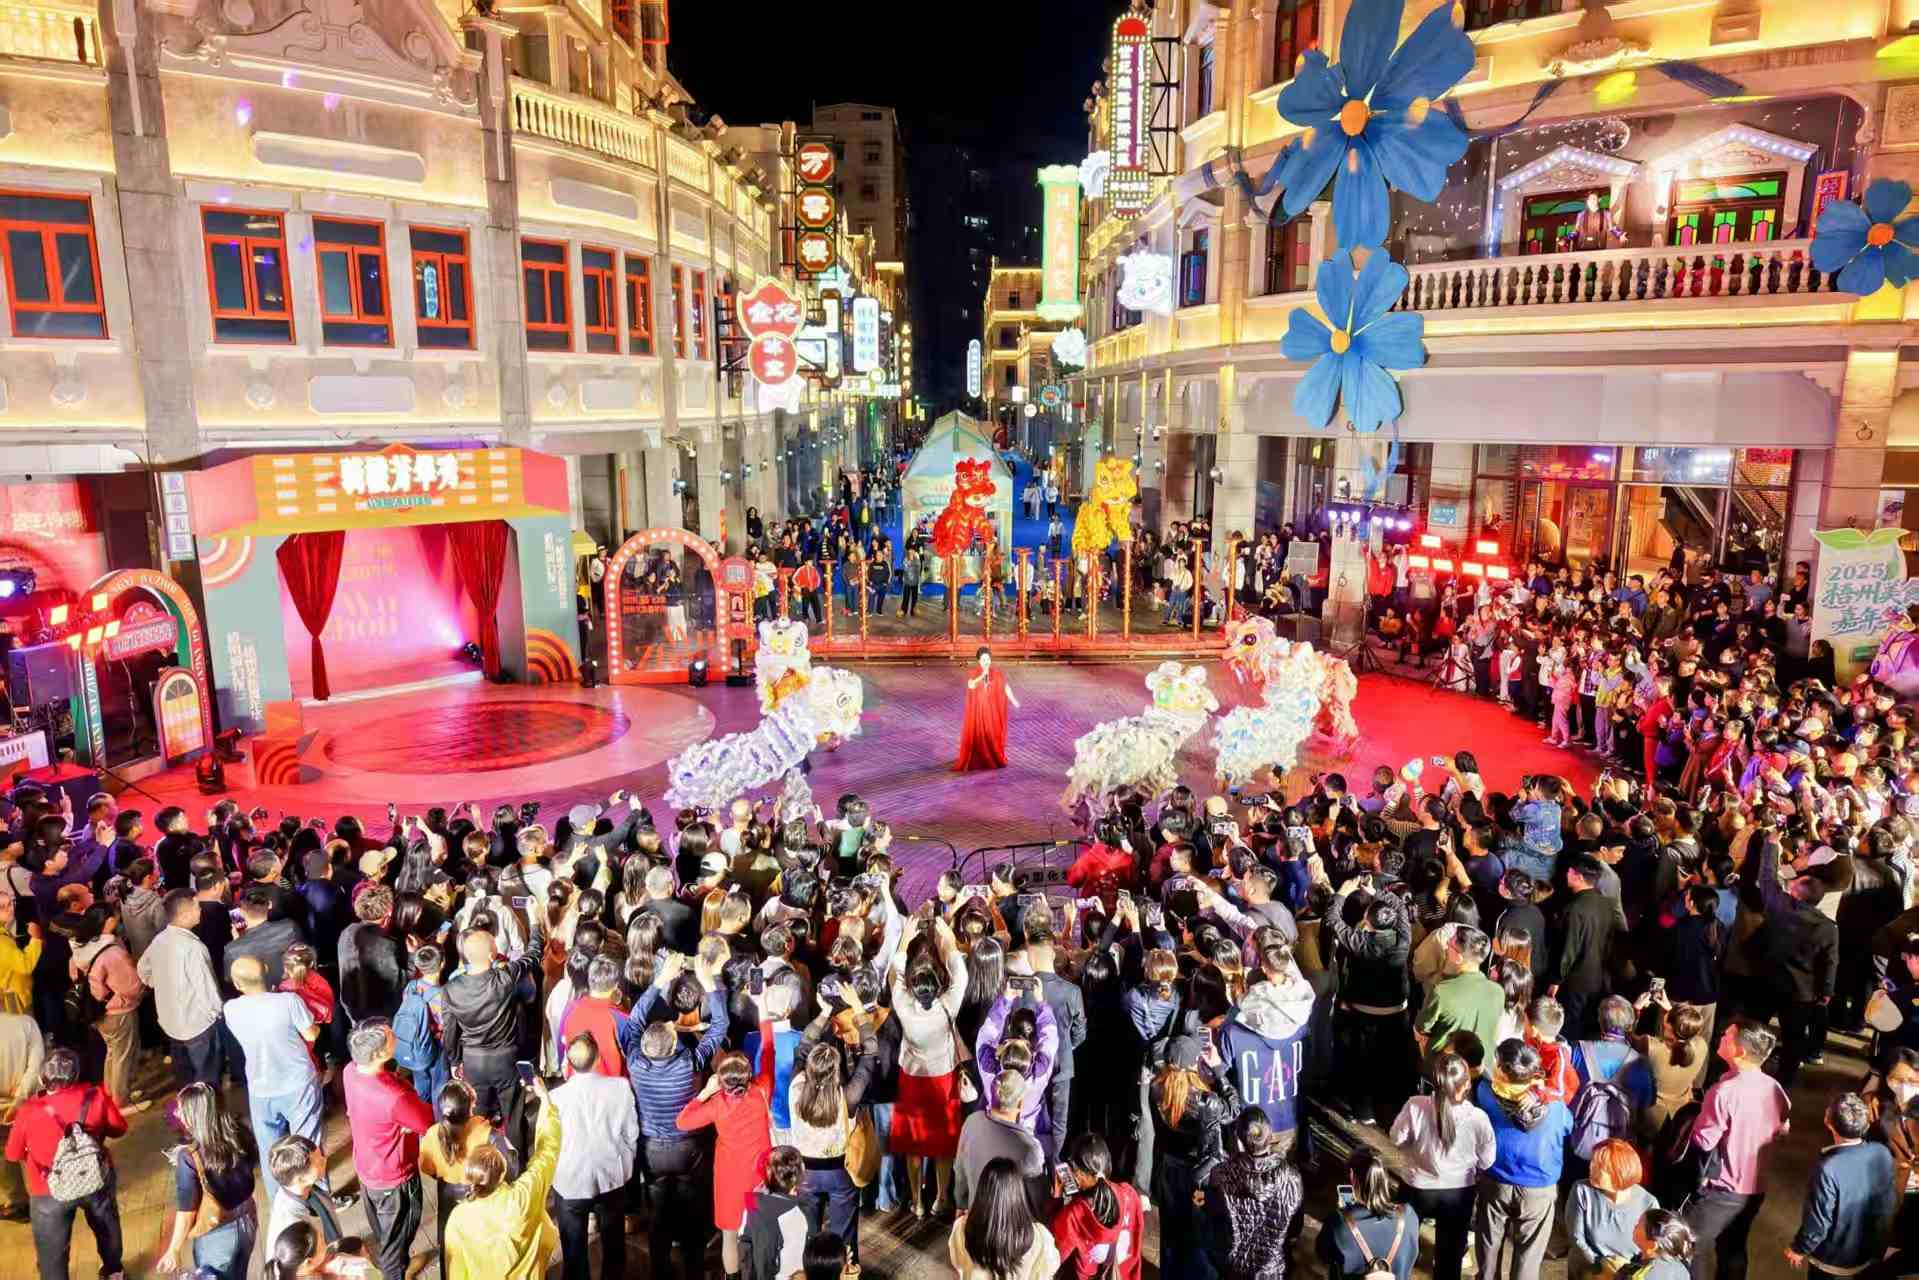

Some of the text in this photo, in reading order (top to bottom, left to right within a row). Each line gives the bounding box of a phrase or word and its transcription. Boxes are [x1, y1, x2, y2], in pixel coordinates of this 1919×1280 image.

[1828, 563, 1888, 581] 2025
[1832, 607, 1890, 635] 嘉年
[1242, 1040, 1303, 1105] GAP
